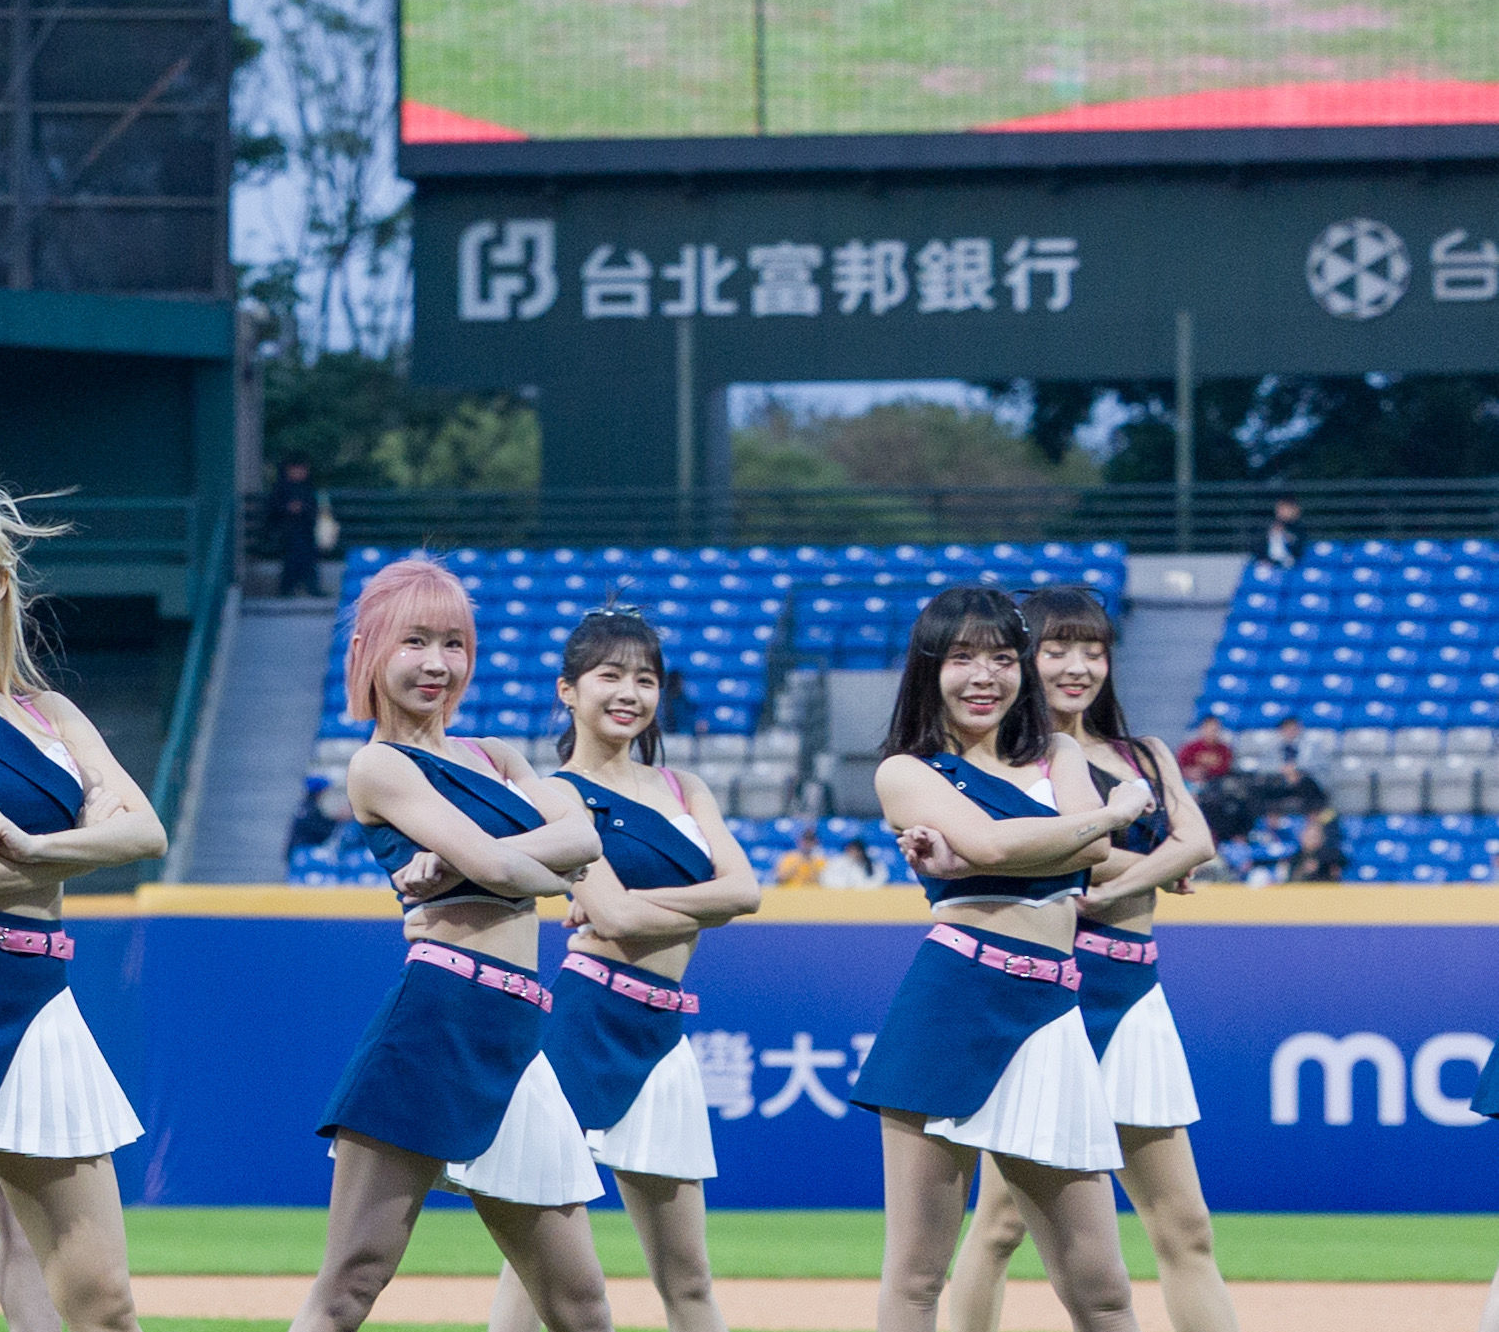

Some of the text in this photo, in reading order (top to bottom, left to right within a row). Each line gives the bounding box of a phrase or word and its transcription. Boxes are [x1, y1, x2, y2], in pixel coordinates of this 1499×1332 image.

[581, 237, 1079, 317] 台北富邦銀行
